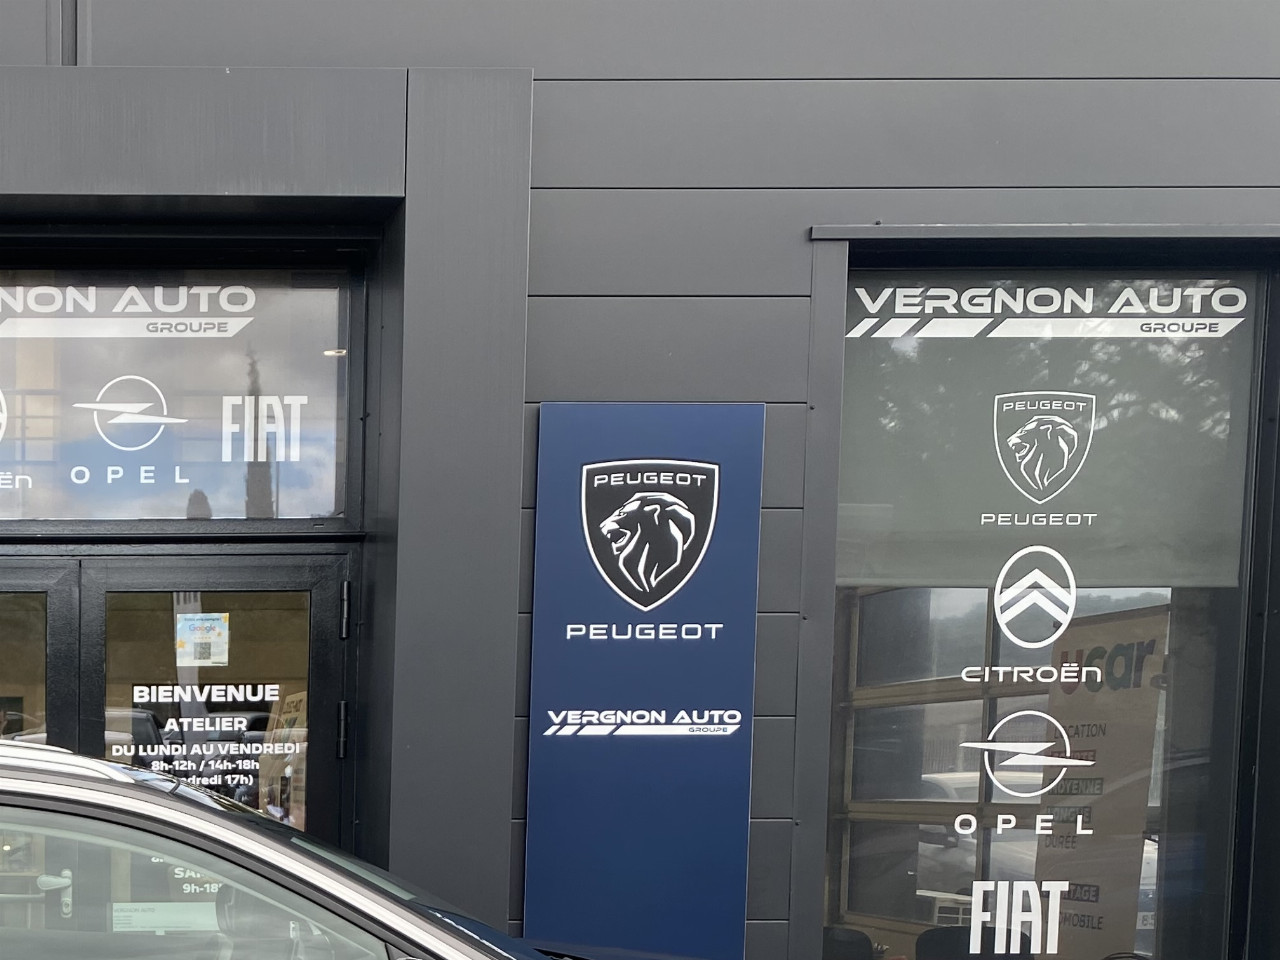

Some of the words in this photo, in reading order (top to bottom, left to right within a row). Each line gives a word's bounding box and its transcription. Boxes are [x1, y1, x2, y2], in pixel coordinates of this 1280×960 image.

[112, 286, 257, 313] AUTO
[854, 287, 1094, 314] VERGNON
[1107, 287, 1247, 314] AUTO
[146, 321, 229, 334] GROUPE
[1139, 322, 1220, 334] GROUPE
[1002, 401, 1087, 413] PEUGEOT
[221, 396, 308, 463] FIAT
[70, 466, 191, 485] OPEL
[593, 472, 707, 488] PEUGEOT
[980, 513, 1098, 526] PEUGEOT
[189, 624, 217, 633] Google
[566, 623, 724, 641] PEUGEOT
[960, 662, 1103, 683] CITROËN
[132, 684, 280, 703] BIENVENUE
[163, 717, 248, 732] ATELIER
[547, 710, 666, 724] VERGNON
[671, 710, 742, 724] AUTO
[111, 744, 135, 756] DU
[138, 744, 187, 756] LUNDI
[190, 743, 214, 755] AU
[217, 742, 300, 755] VENDREDI
[151, 760, 197, 771] 8h-12h
[208, 759, 260, 770] 14h-18h
[224, 774, 254, 786] 17h)
[954, 814, 1094, 835] OPEL
[182, 883, 222, 893] 9h-18
[968, 880, 1070, 954] FIAT
